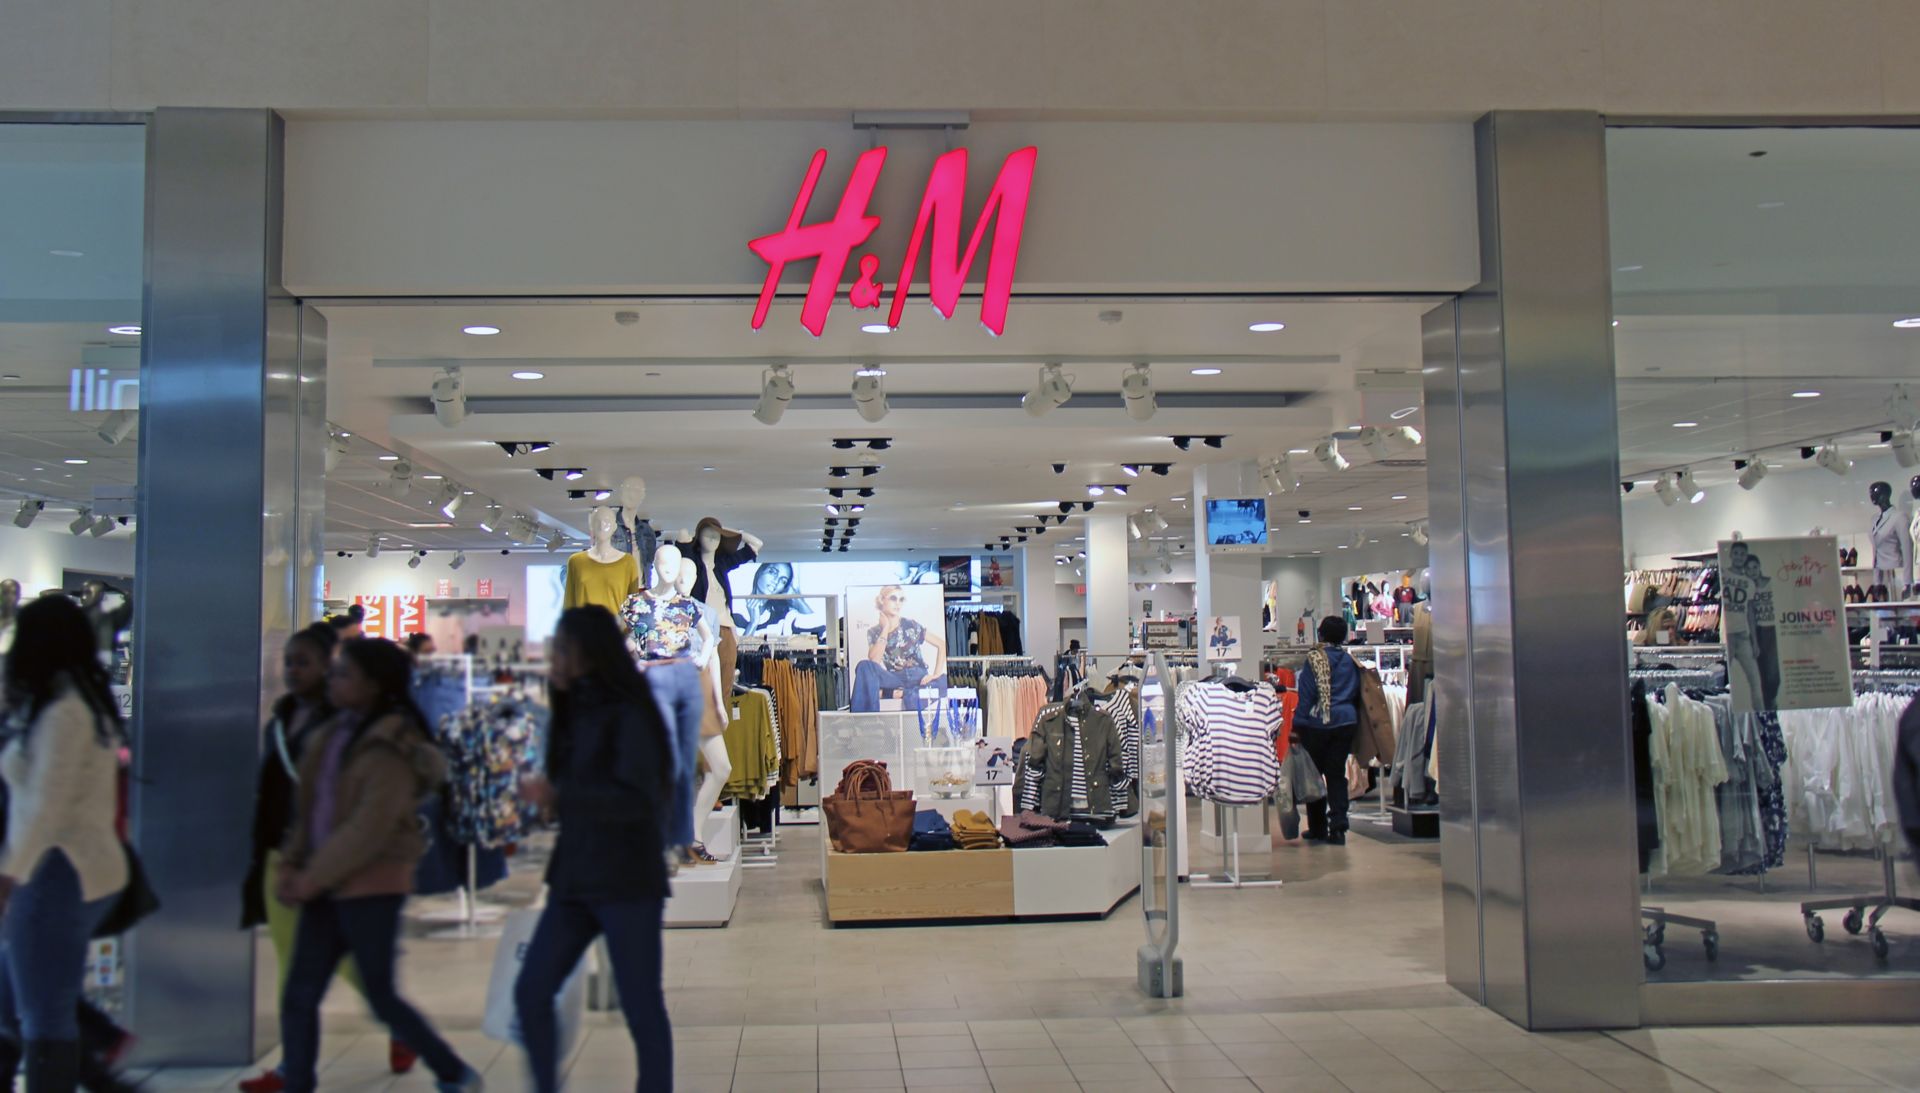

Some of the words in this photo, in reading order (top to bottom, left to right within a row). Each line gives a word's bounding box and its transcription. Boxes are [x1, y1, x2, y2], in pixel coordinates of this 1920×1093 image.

[748, 146, 1038, 337] H&M
[1722, 586, 1747, 604] AD
[1779, 610, 1811, 624] JOIN
[1814, 609, 1836, 621] US!
[1216, 648, 1227, 657] 17
[986, 770, 998, 780] 17
